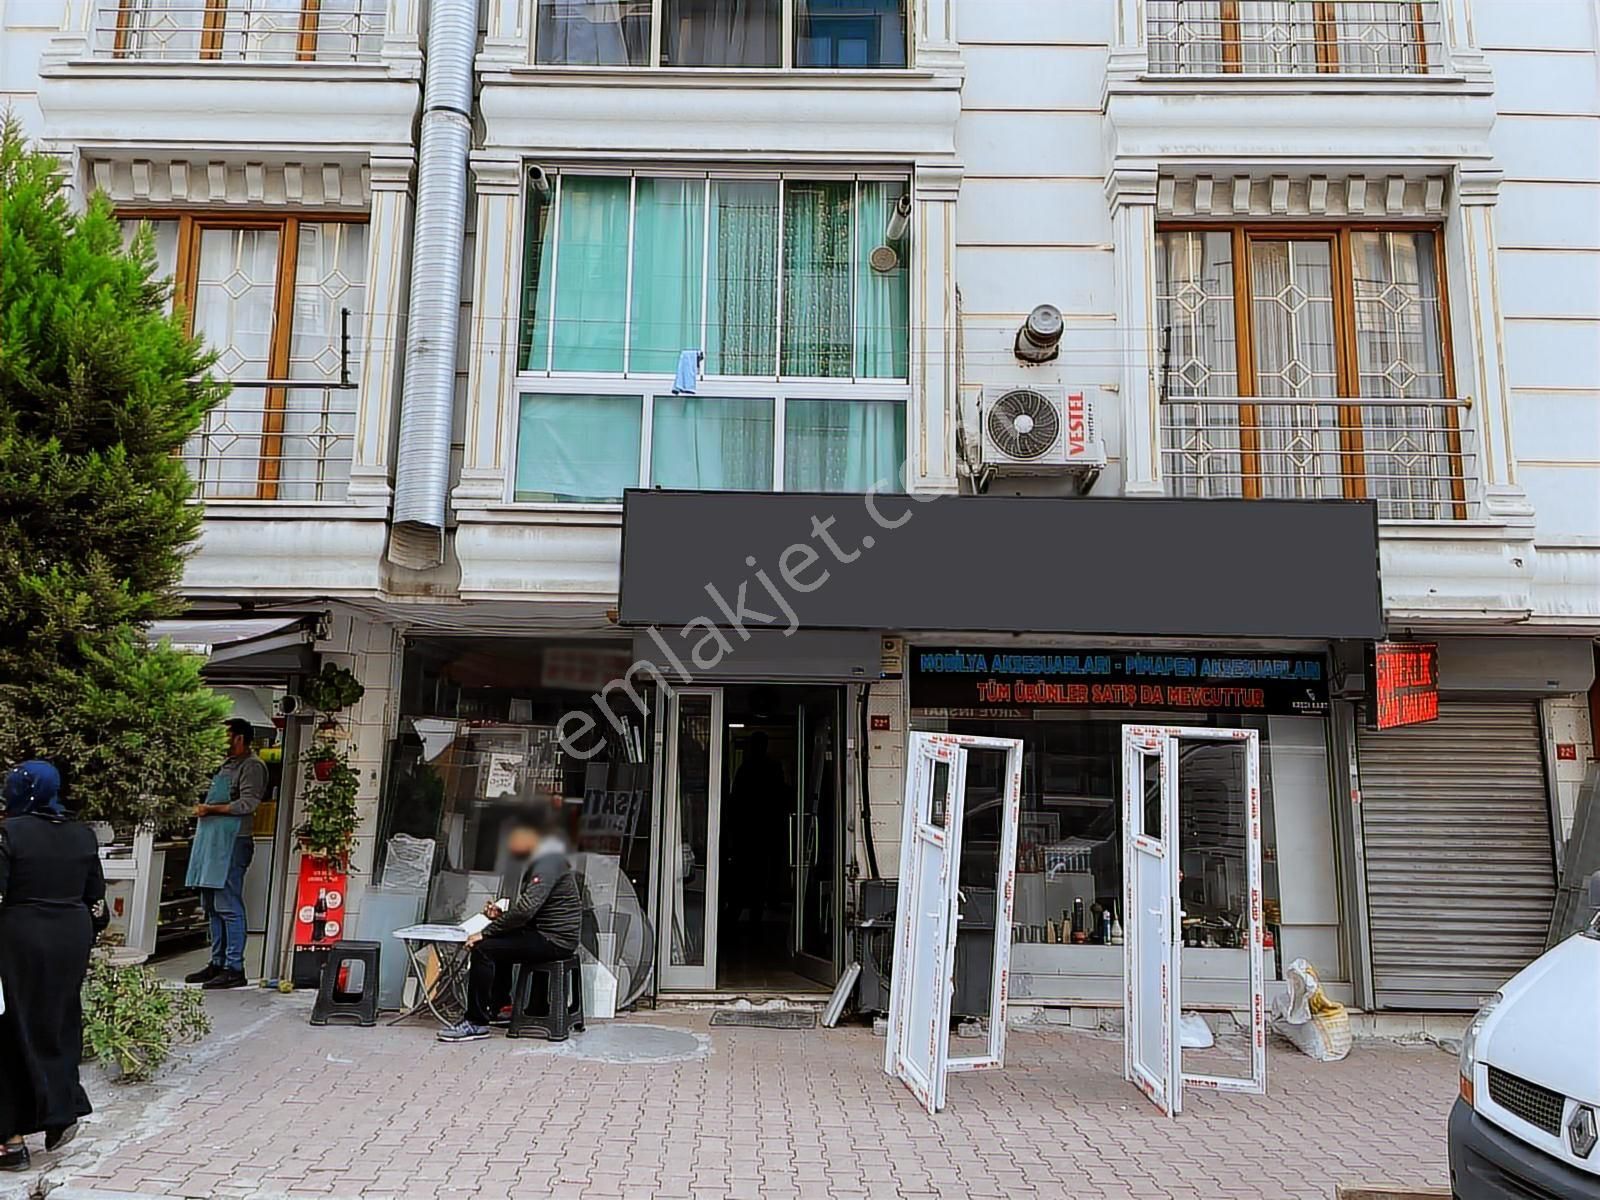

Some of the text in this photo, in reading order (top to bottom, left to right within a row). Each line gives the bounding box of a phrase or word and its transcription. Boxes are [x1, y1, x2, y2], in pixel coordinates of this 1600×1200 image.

[1068, 391, 1085, 456] VESTEL
[920, 650, 987, 673] MOBİLYA
[1126, 651, 1197, 677] PİMAPEN
[977, 679, 1265, 708] TÜM ÜRÜNLER SATIŞ DA MEVCUTTUR
